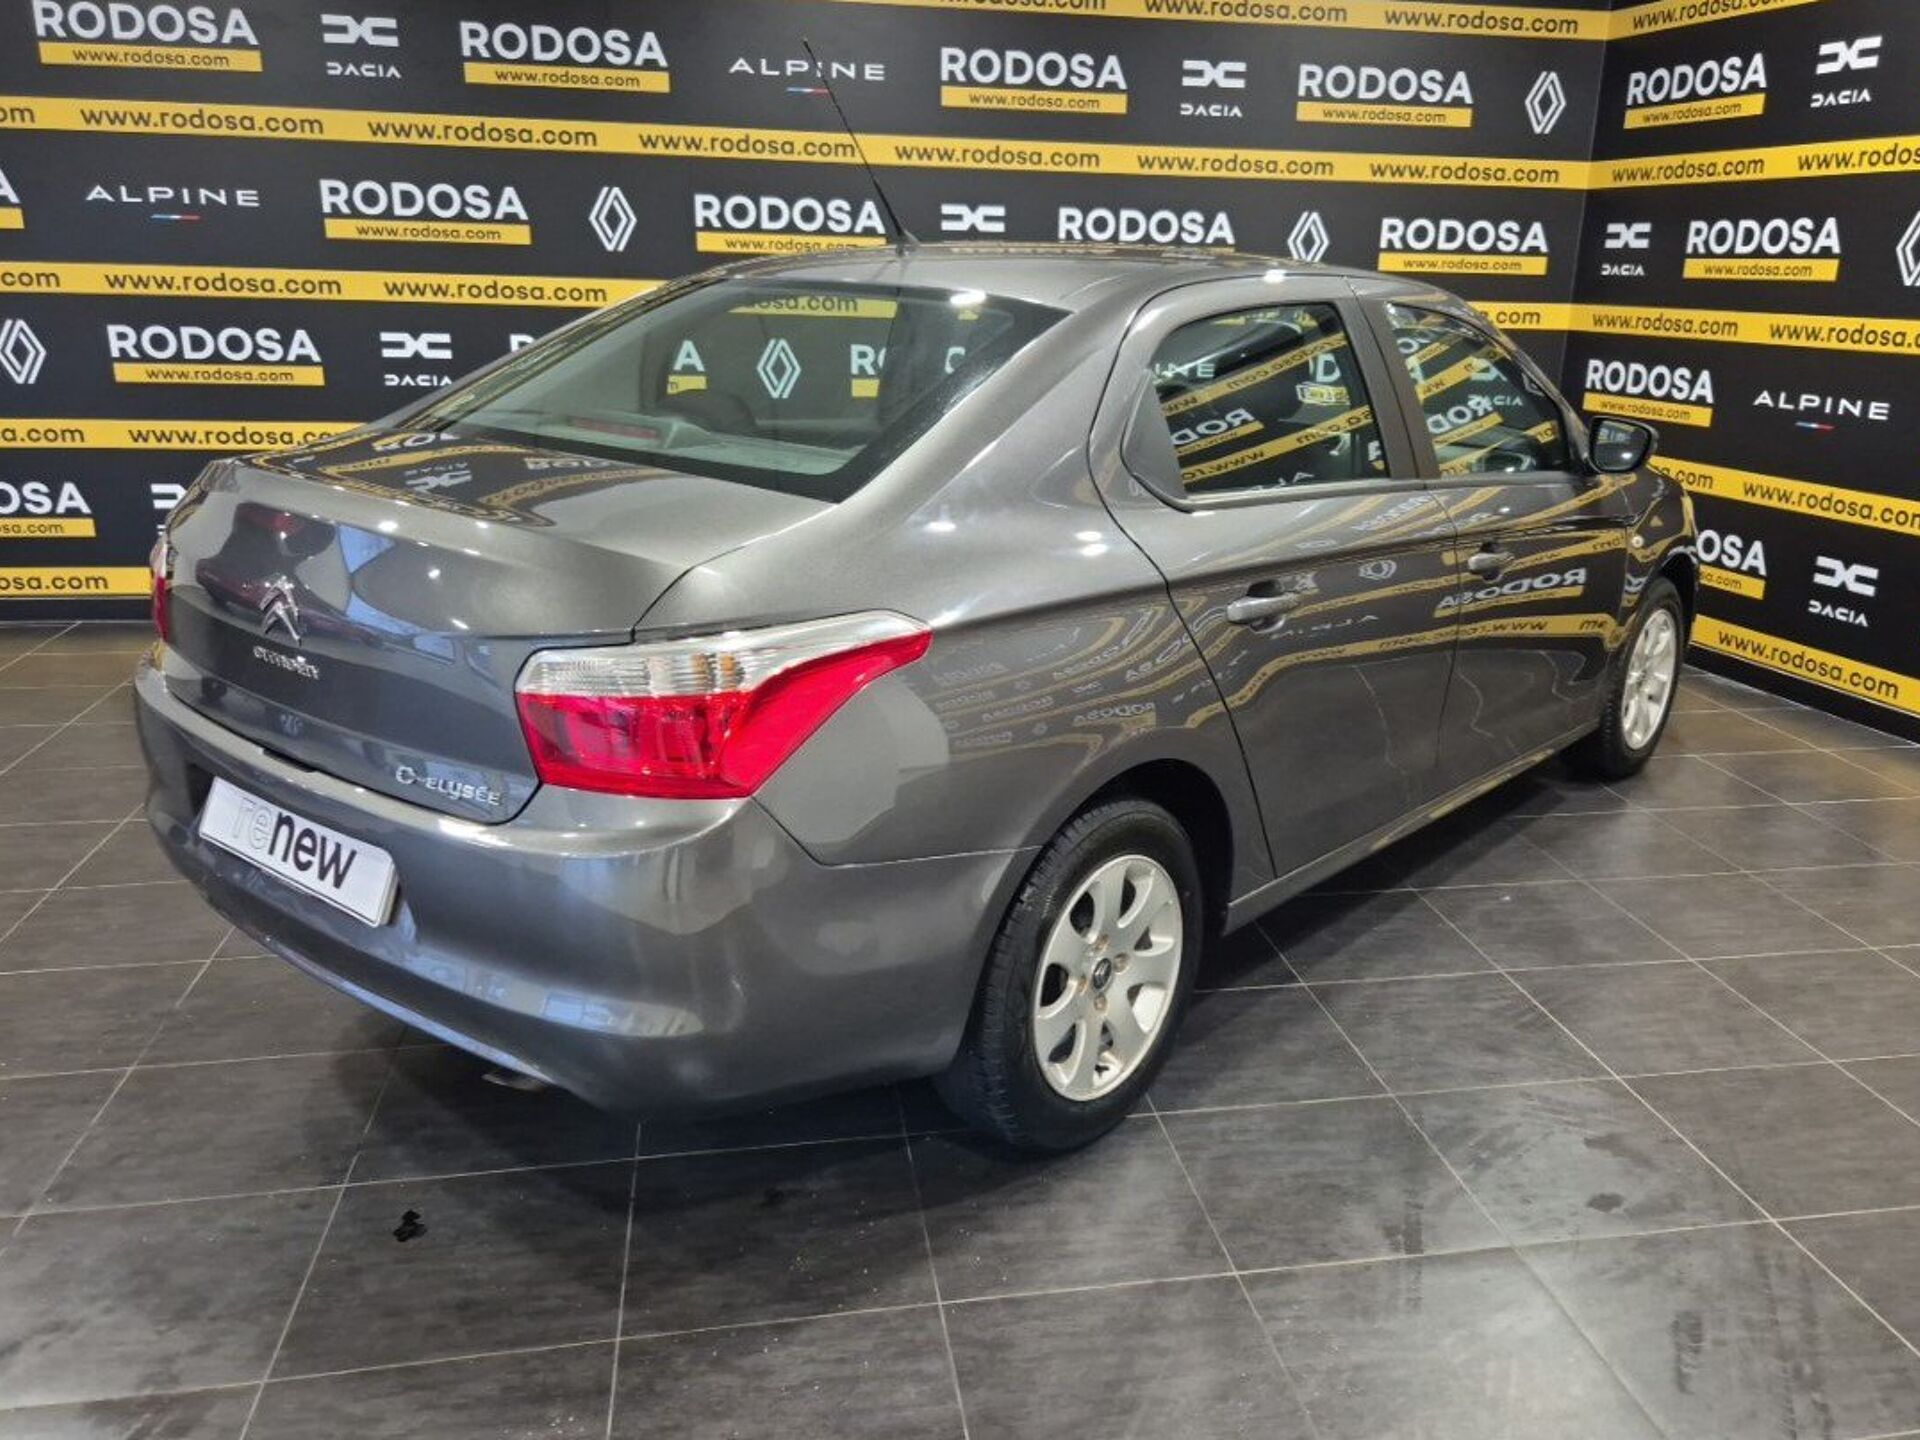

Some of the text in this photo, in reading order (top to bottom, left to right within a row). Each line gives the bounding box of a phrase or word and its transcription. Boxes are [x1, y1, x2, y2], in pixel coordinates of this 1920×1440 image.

[1145, 0, 1348, 22] www.rodosa.com
[1385, 10, 1578, 34] www.rodosa.com
[32, 0, 260, 46] RODOSA
[460, 21, 668, 68] RODOSA
[73, 48, 230, 67] www.rodosa.com
[729, 57, 886, 81] ALPINE
[940, 47, 1128, 90] RODOSA
[326, 61, 402, 79] DACIA
[495, 68, 641, 88] www.rodosa.com
[1626, 52, 1767, 106] RODOSA
[1298, 64, 1473, 104] RODOSA
[969, 93, 1100, 109] www.rodosa.com
[1810, 88, 1872, 108] DACIA
[81, 107, 324, 134] www.rodosa.com
[1180, 103, 1243, 118] DACIA
[1323, 106, 1446, 123] www.rodosa.com
[1643, 102, 1742, 123] www.rodosa.com
[368, 119, 598, 147] www.rodosa.com
[640, 131, 856, 158] www.rodosa.com
[895, 144, 1100, 167] www.rodosa.com
[1138, 153, 1334, 175] www.rodosa.com
[1370, 160, 1559, 183] www.rodosa.com
[1612, 156, 1765, 182] www.rodosa.com
[86, 185, 260, 206] ALPINE
[319, 178, 529, 221] RODOSA
[694, 194, 887, 234] RODOSA
[356, 222, 501, 241] www.rodosa.com
[1058, 207, 1235, 245] RODOSA
[1379, 217, 1549, 252] RODOSA
[1685, 217, 1842, 254] RODOSA
[1404, 257, 1522, 271] www.rodosa.com
[1600, 264, 1645, 276] DACIA
[1703, 263, 1812, 277] www.rodosa.com
[105, 273, 342, 296] www.rodosa.com
[384, 280, 607, 301] www.rodosa.com
[1593, 312, 1738, 337] www.rodosa.com
[106, 324, 322, 363] RODOSA
[145, 367, 294, 382] www.rodosa.com
[384, 374, 452, 386] DACIA
[1585, 359, 1714, 404] RODOSA
[1601, 401, 1691, 420] www.rodosa.com
[1753, 390, 1891, 420] ALPINE
[1807, 600, 1868, 627] DACIA
[1718, 630, 1899, 699] www.rodosa.com
